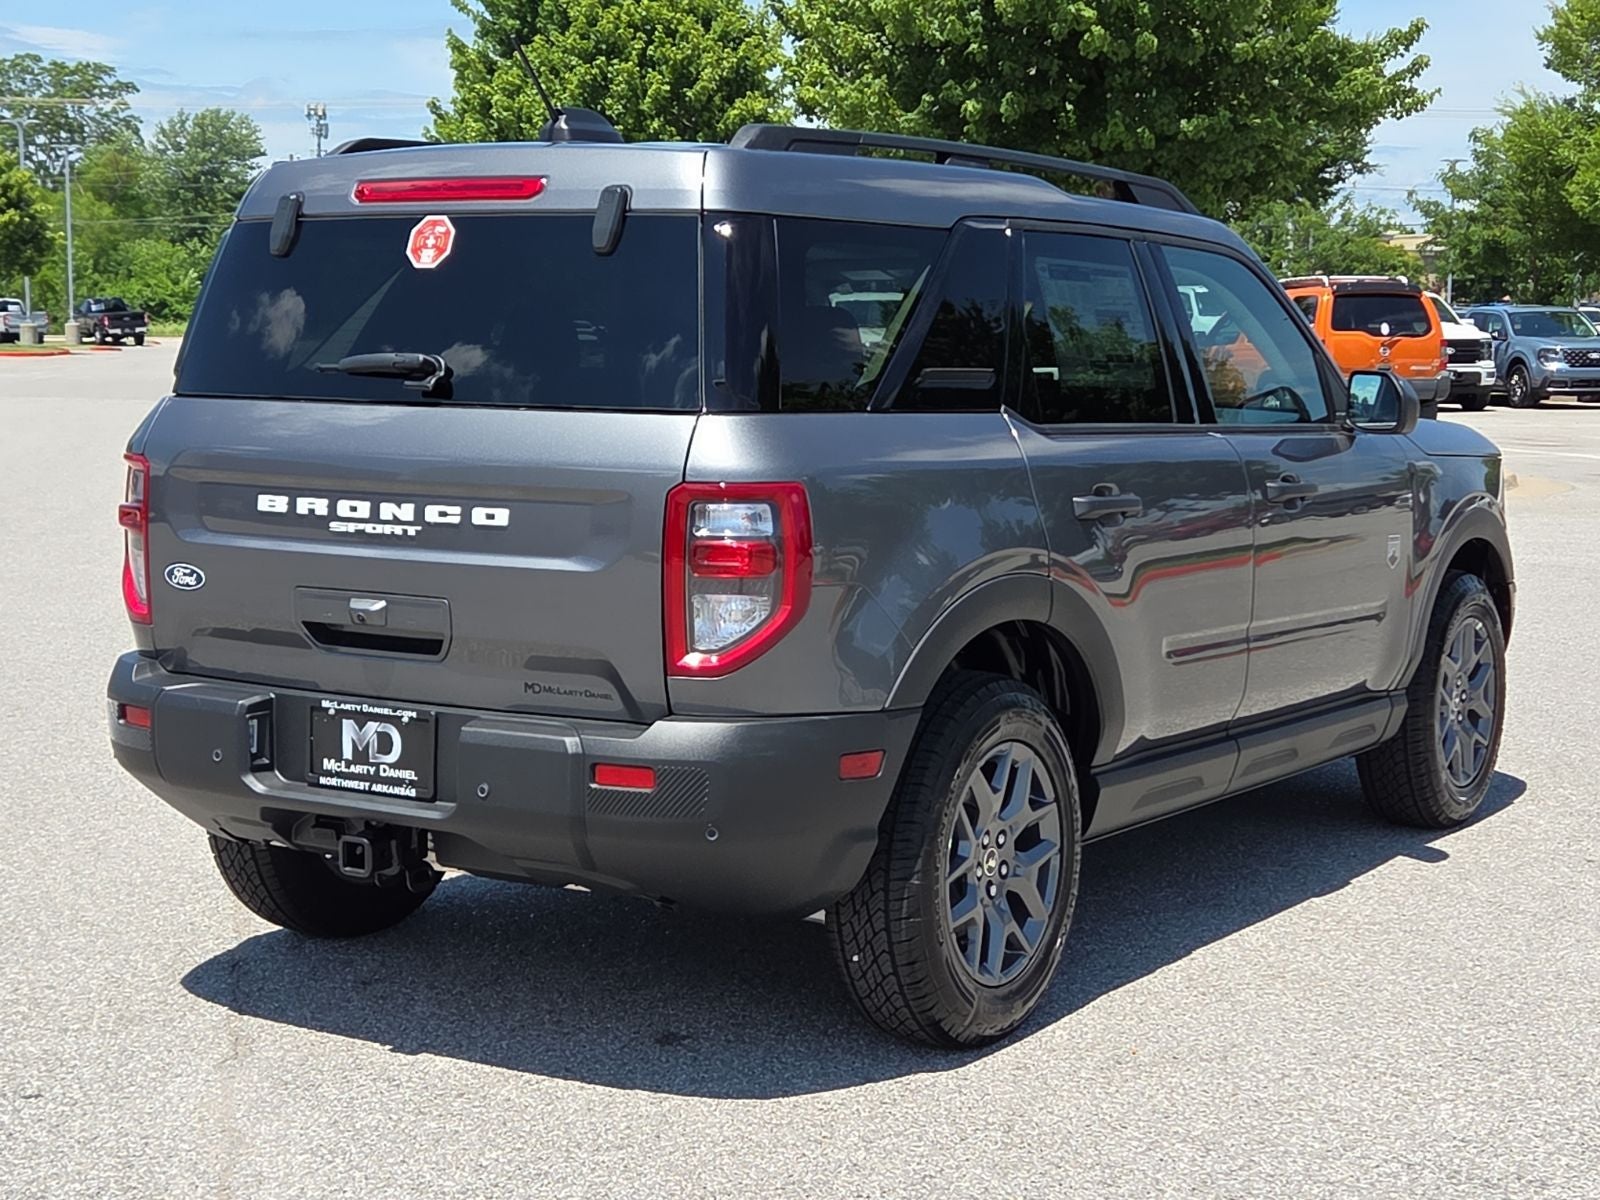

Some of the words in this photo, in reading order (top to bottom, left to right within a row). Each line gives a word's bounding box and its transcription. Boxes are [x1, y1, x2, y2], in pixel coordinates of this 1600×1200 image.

[257, 494, 510, 526] BRONCO
[328, 521, 422, 536] SPORT
[172, 567, 197, 585] Ford
[342, 718, 402, 763] MD
[379, 765, 418, 780] DANIEL
[319, 776, 370, 790] NORTHWEST
[371, 784, 417, 797] ARKANSAS
